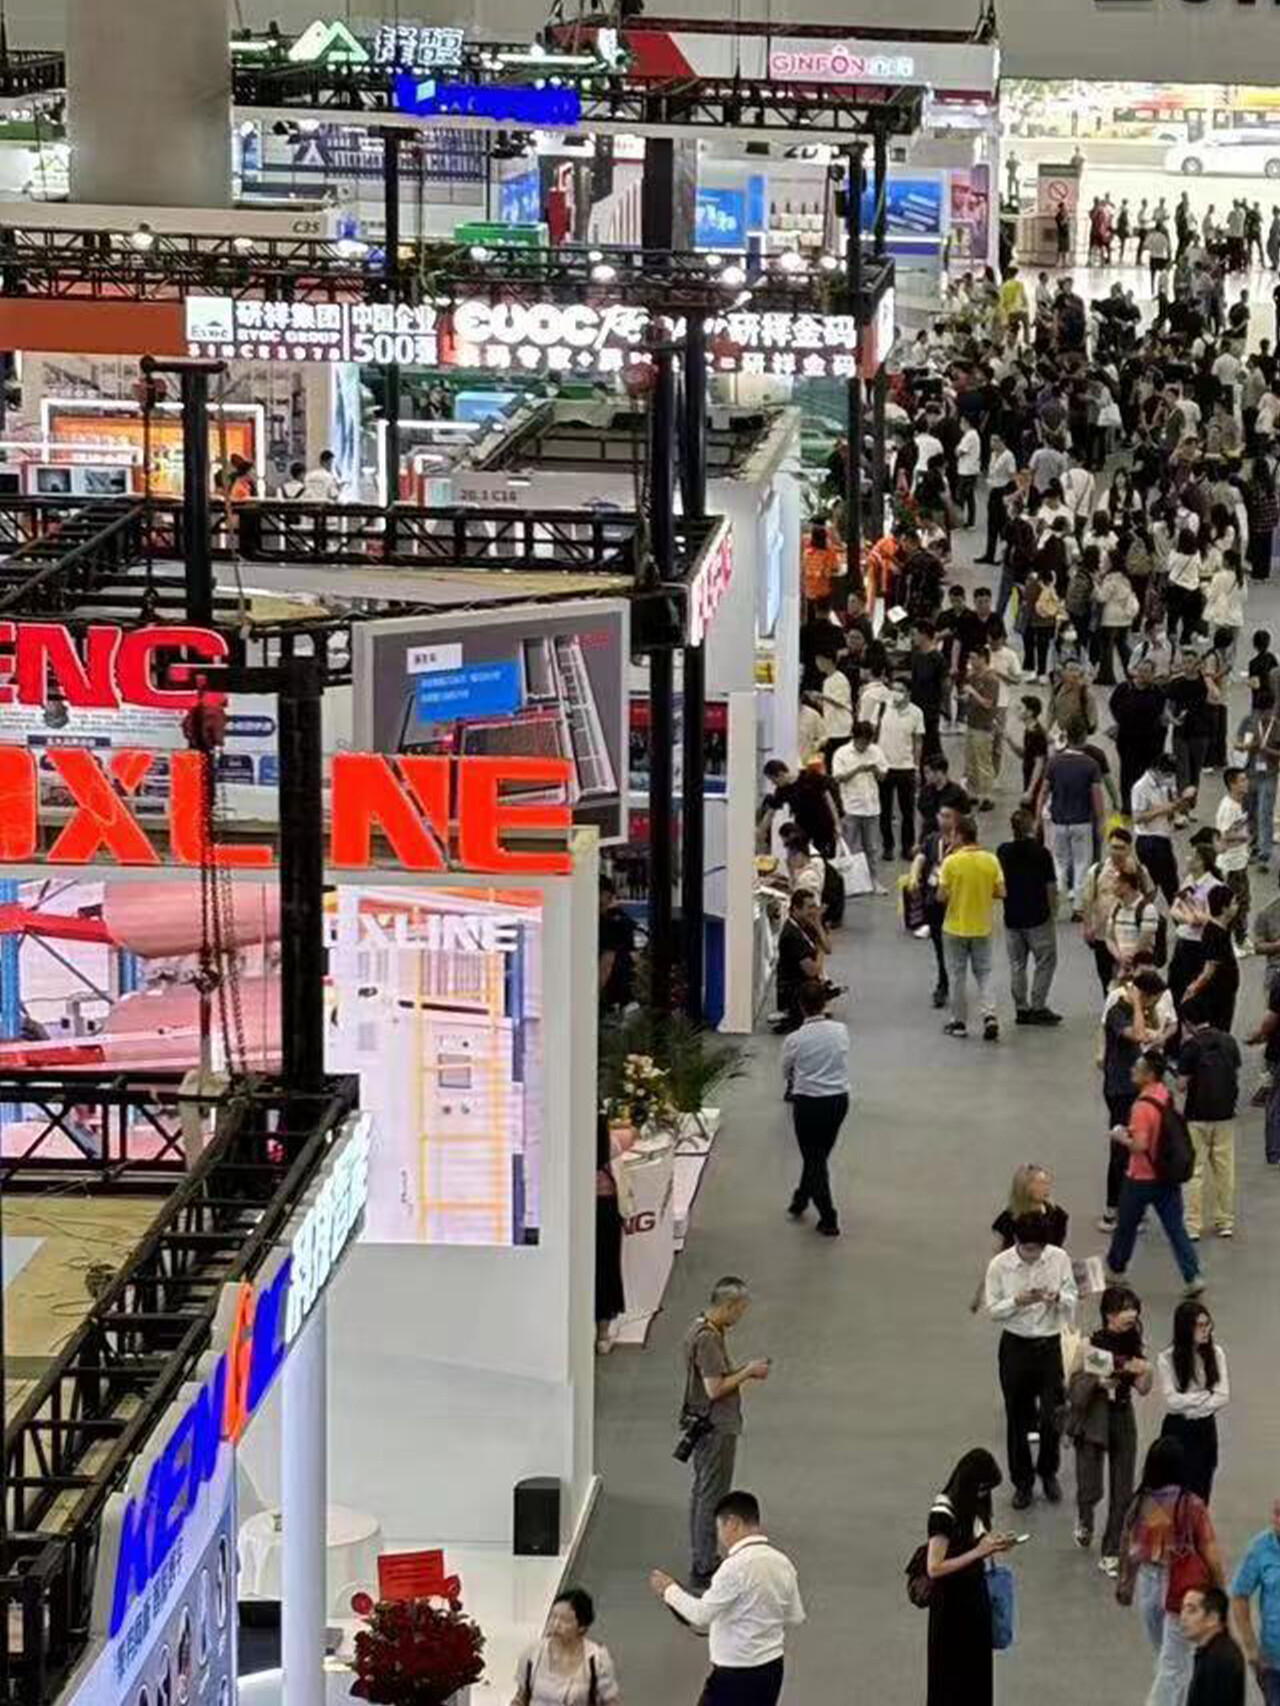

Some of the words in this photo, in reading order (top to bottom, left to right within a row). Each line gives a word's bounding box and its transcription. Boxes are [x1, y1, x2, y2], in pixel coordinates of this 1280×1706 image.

[236, 301, 341, 329] 研祥集团
[352, 302, 438, 333] 中国企业
[285, 330, 341, 344] GROUP
[0, 621, 230, 712] NG
[0, 747, 575, 873] XLNE
